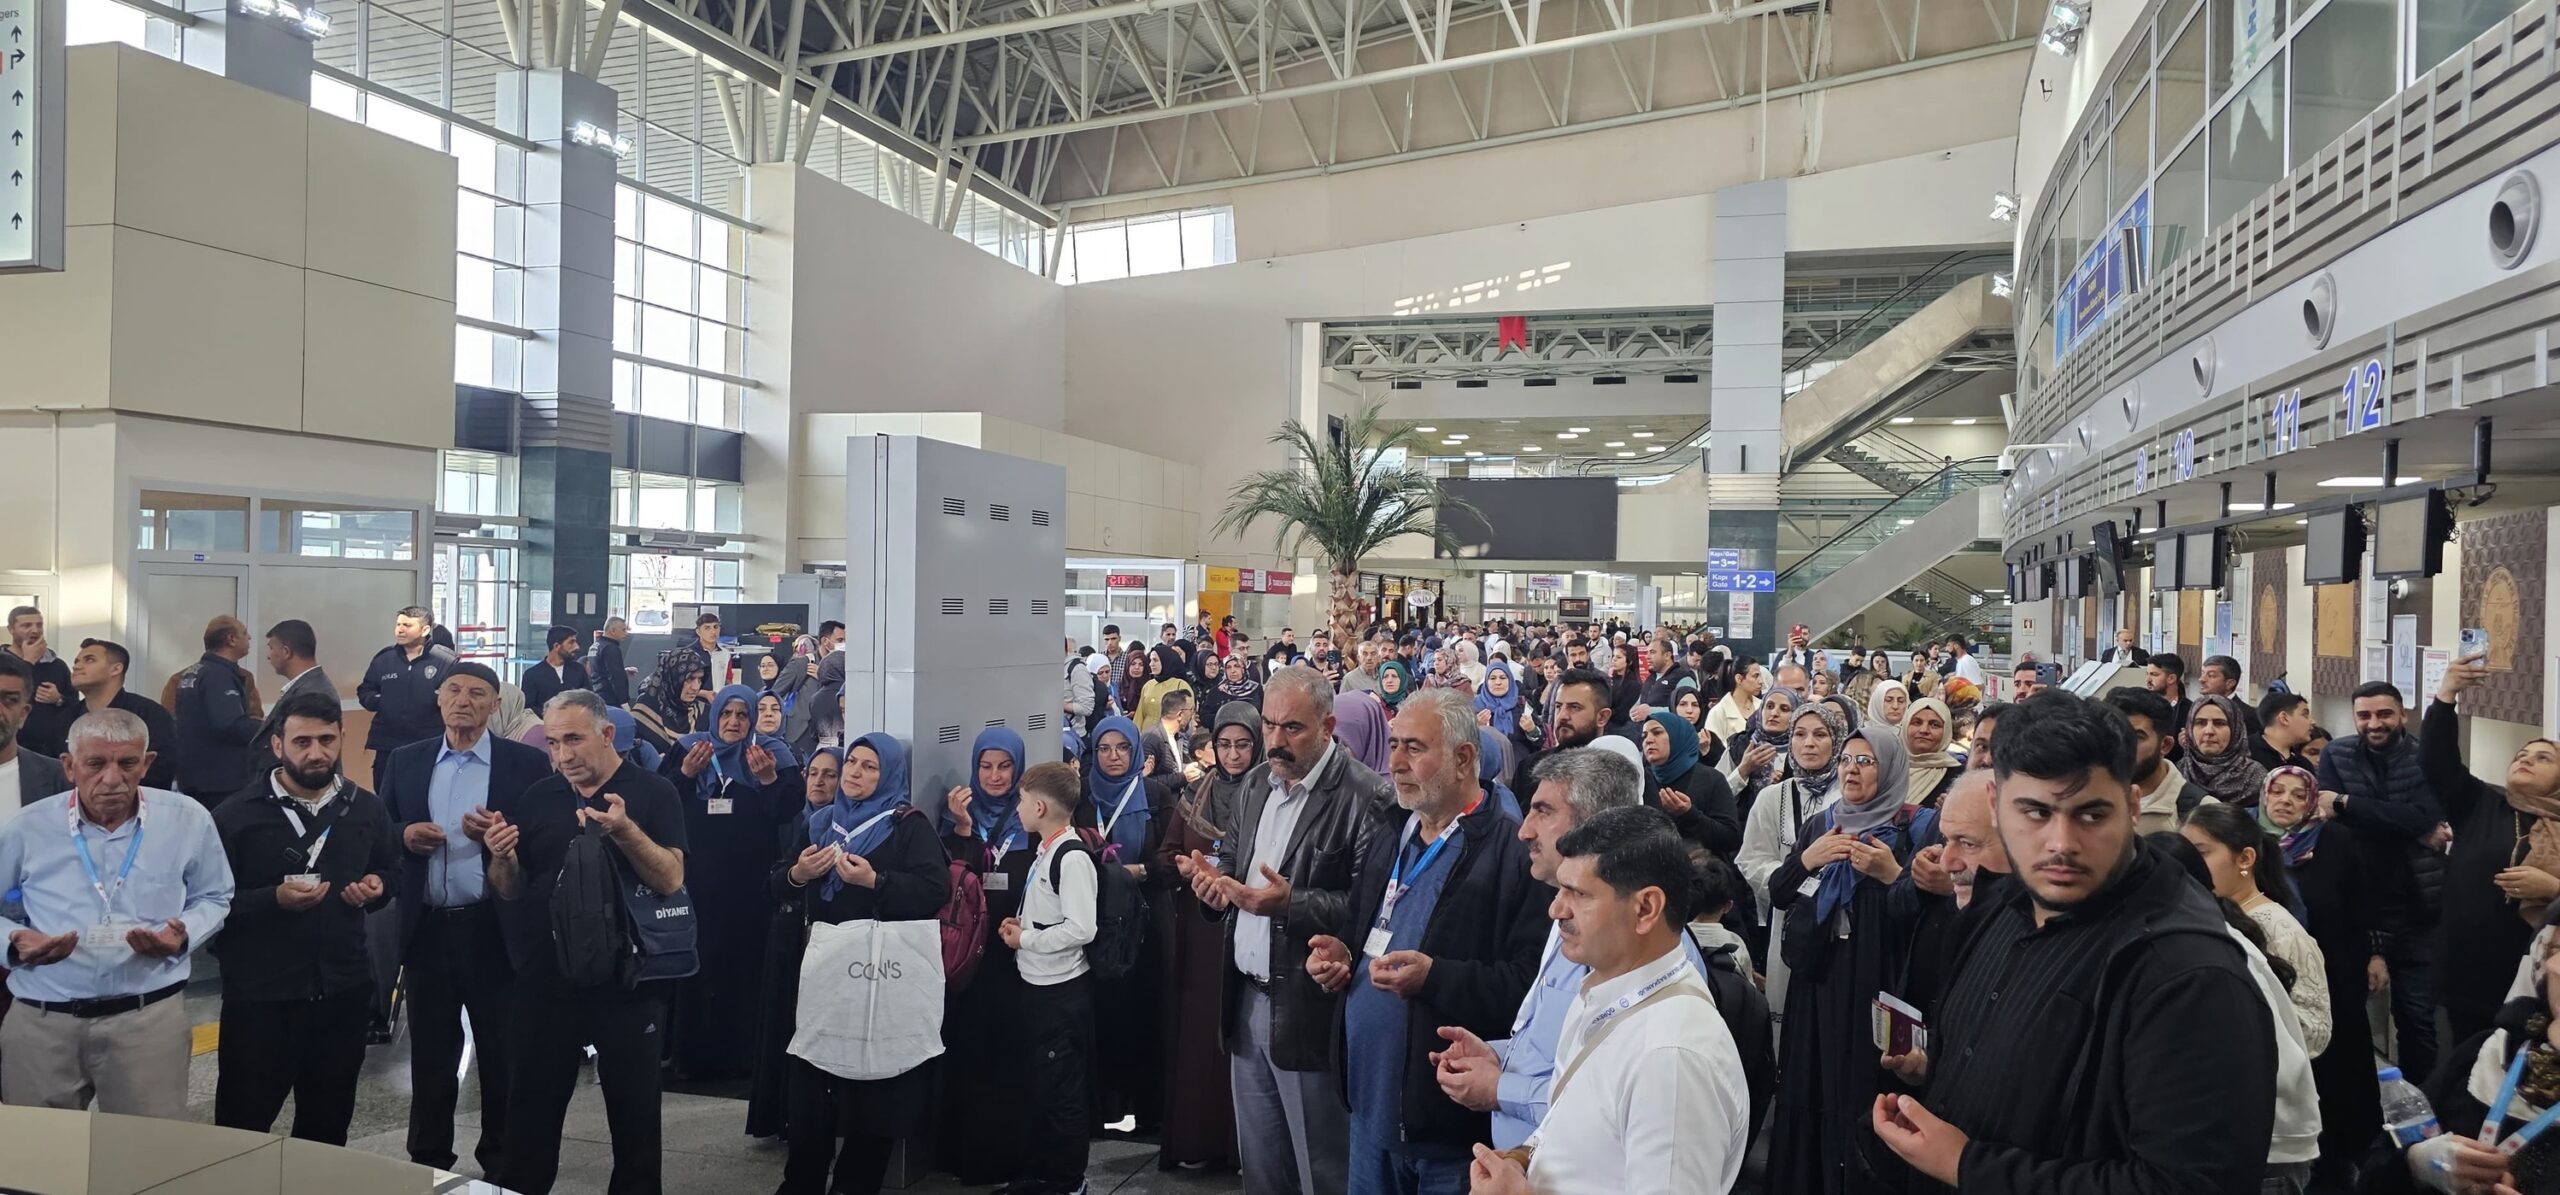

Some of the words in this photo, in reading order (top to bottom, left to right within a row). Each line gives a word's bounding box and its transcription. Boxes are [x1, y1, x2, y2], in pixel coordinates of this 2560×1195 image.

[2343, 359, 2383, 435] 12
[2272, 388, 2300, 455] 11
[2135, 447, 2146, 495] 9
[2174, 428, 2194, 483] 10
[1721, 559, 1727, 568] 3
[1733, 574, 1757, 588] 1-2
[655, 906, 689, 919] DİYANET
